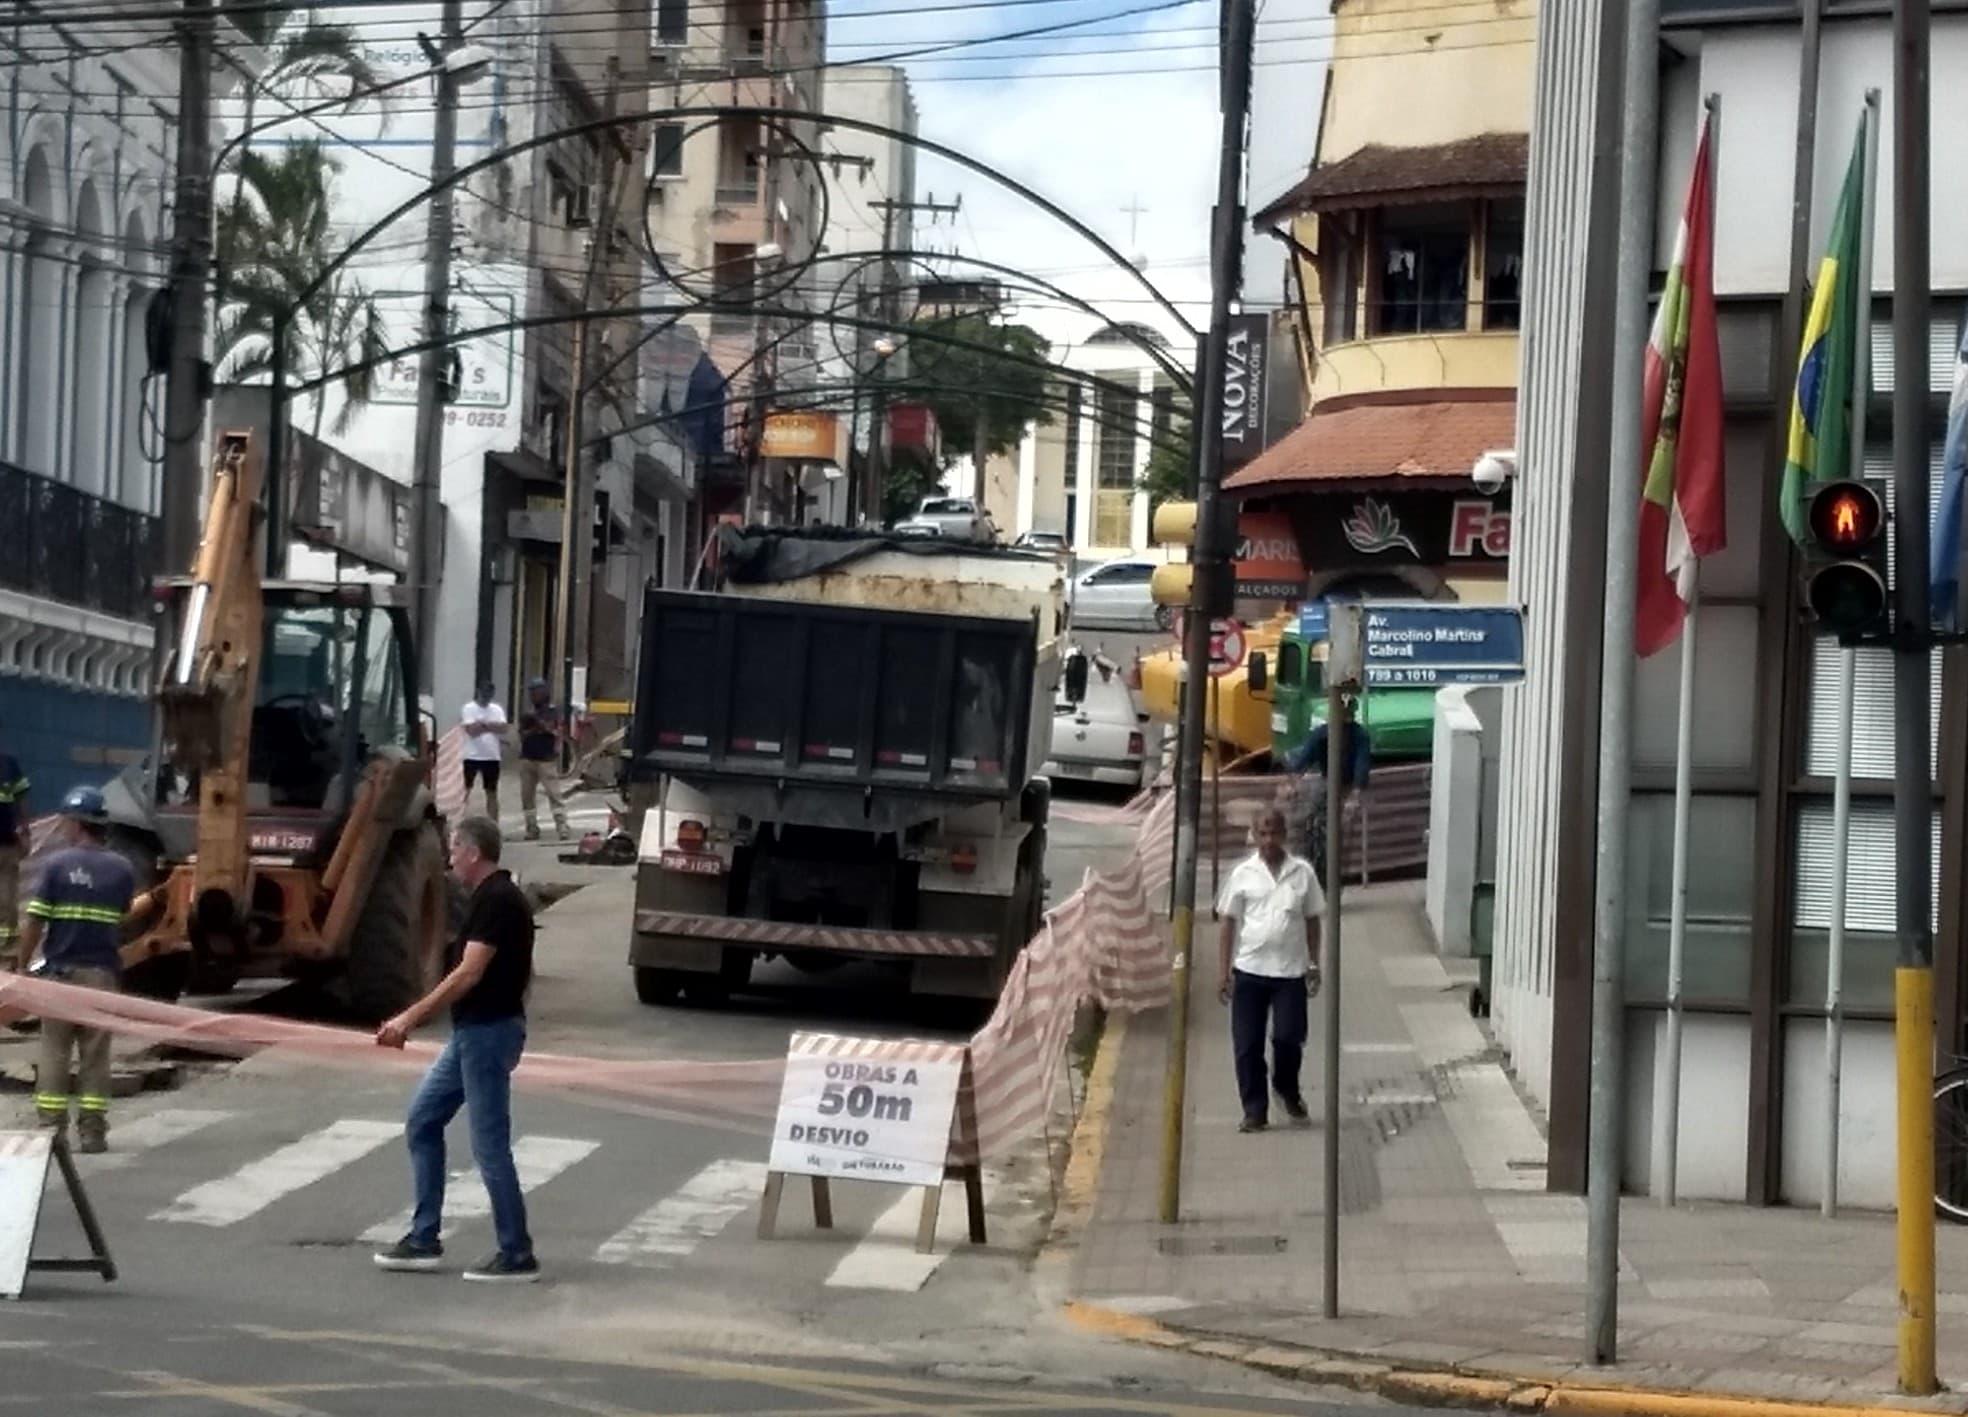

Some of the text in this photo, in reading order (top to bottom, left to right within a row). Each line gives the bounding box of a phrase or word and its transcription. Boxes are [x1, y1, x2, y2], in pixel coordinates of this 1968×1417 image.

[1221, 329, 1249, 444] NOVA
[445, 411, 507, 428] 9-0252
[1235, 584, 1298, 597] ALÇADOS
[1367, 615, 1390, 628] Av.
[1367, 628, 1486, 643] Marcolino Martins
[1367, 643, 1414, 657] Cabral
[824, 1061, 919, 1086] OBRAS A
[817, 1082, 913, 1122] 50m
[789, 1123, 870, 1148] DESVIO
